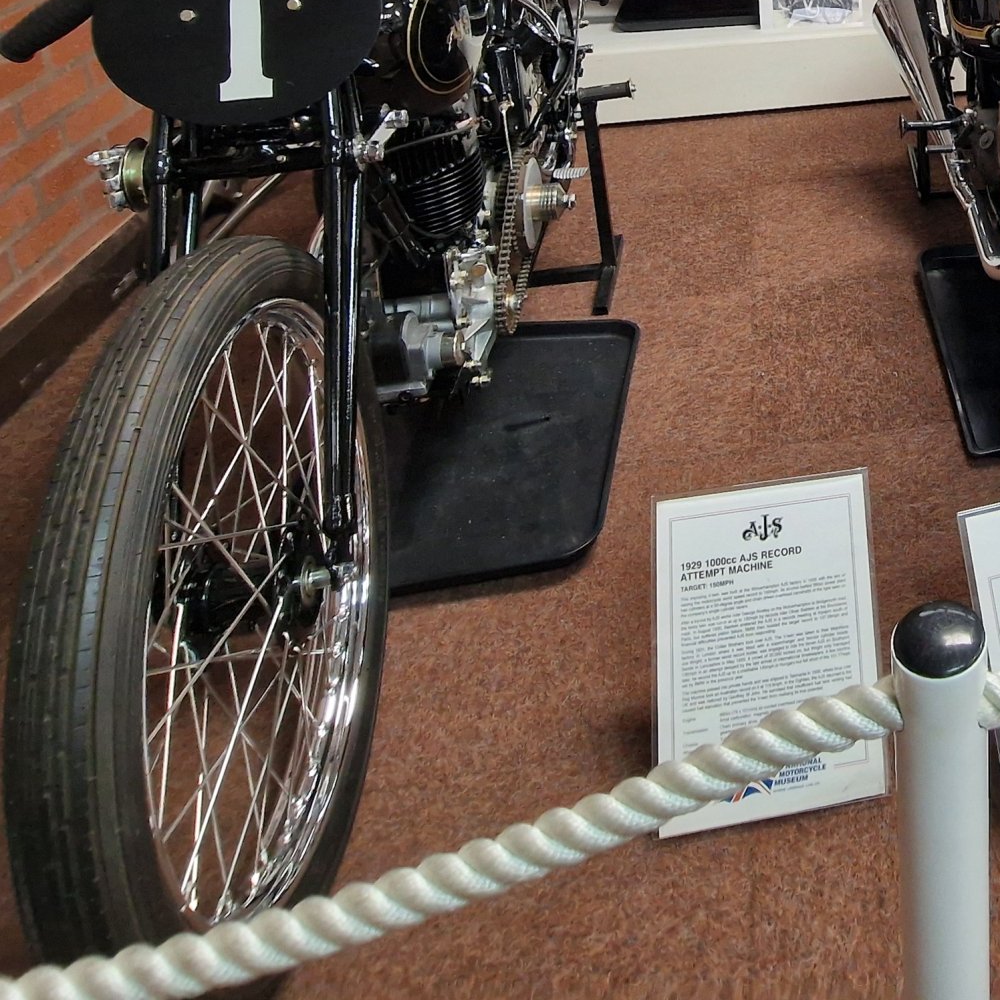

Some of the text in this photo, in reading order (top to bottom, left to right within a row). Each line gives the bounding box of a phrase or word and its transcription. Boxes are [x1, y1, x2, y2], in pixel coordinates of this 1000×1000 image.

[681, 545, 802, 571] 1929 1000cc AJS RECORD
[680, 560, 773, 582] ATTEMPT MACHINE
[709, 580, 734, 588] 150MPH
[779, 764, 826, 777] MOTORCYCLE
[774, 775, 809, 785] MUSEUM
